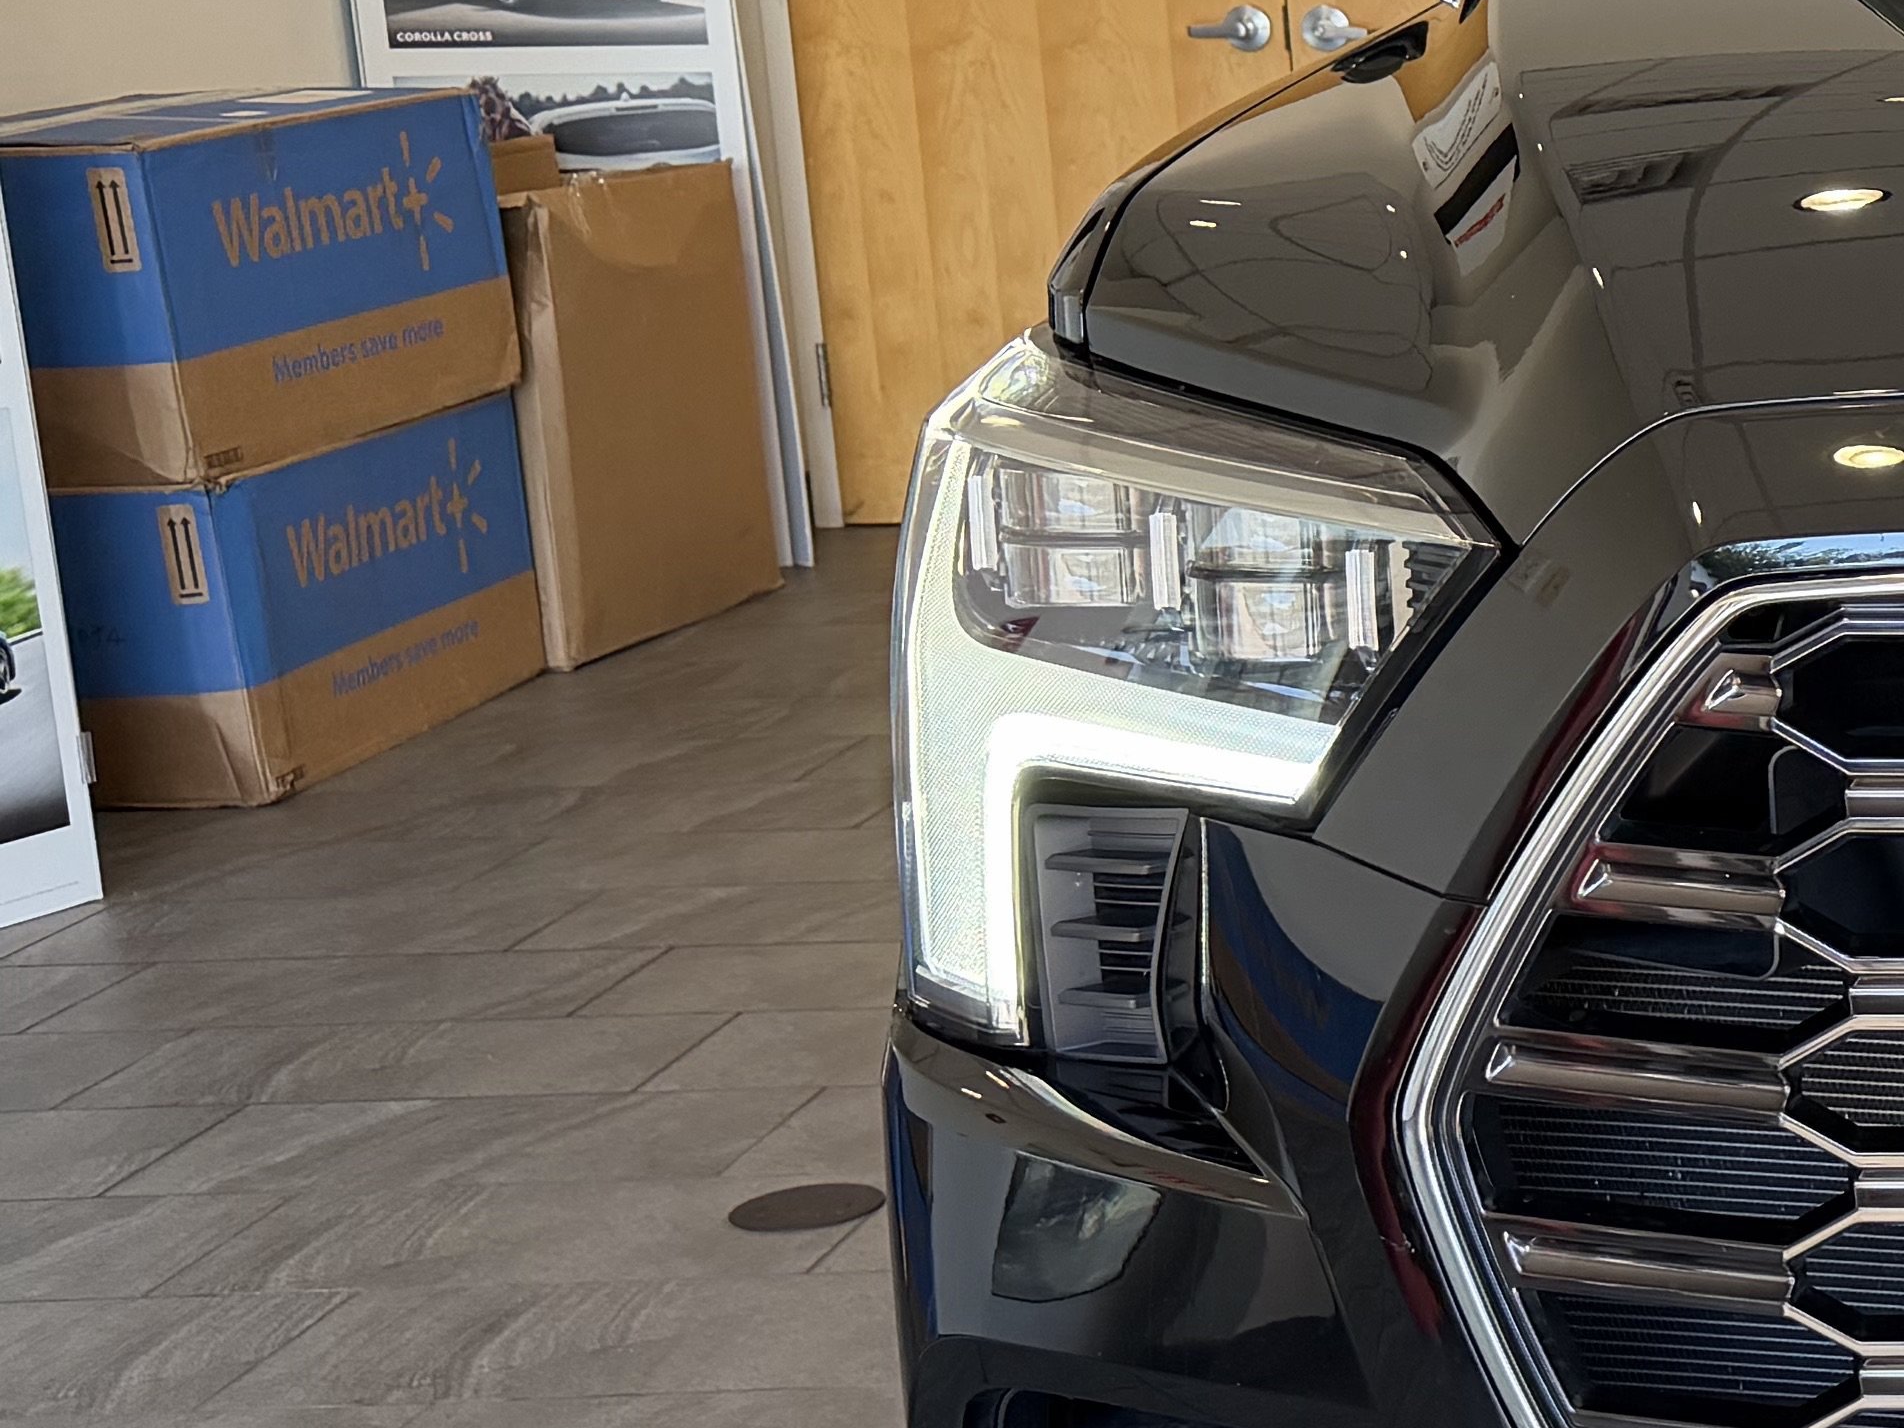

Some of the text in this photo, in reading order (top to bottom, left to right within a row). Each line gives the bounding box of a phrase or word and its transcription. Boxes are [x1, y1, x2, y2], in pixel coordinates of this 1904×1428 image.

[396, 30, 493, 43] COROLLA CROSS
[272, 319, 444, 384] Members save more
[332, 655, 404, 698] Members
